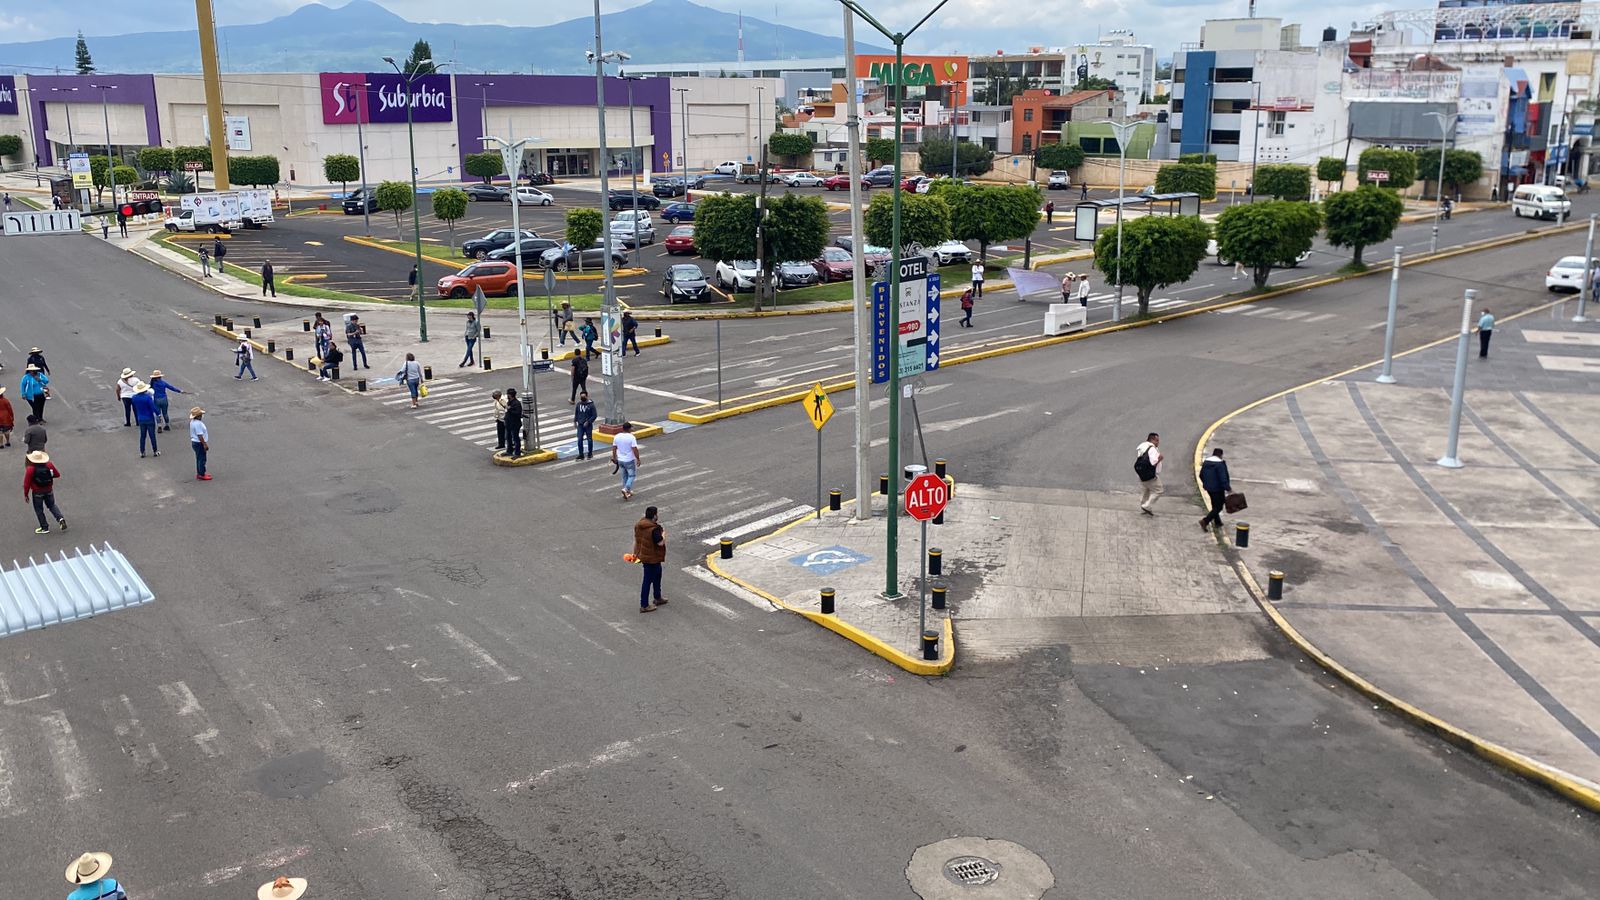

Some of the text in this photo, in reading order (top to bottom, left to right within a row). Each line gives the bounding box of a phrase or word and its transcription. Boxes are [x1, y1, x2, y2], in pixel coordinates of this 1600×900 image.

[379, 84, 445, 112] Suburbia
[132, 192, 158, 200] ENTRADA
[899, 262, 925, 278] OTEL
[899, 299, 920, 308] STANZA
[909, 486, 944, 509] ALTO
